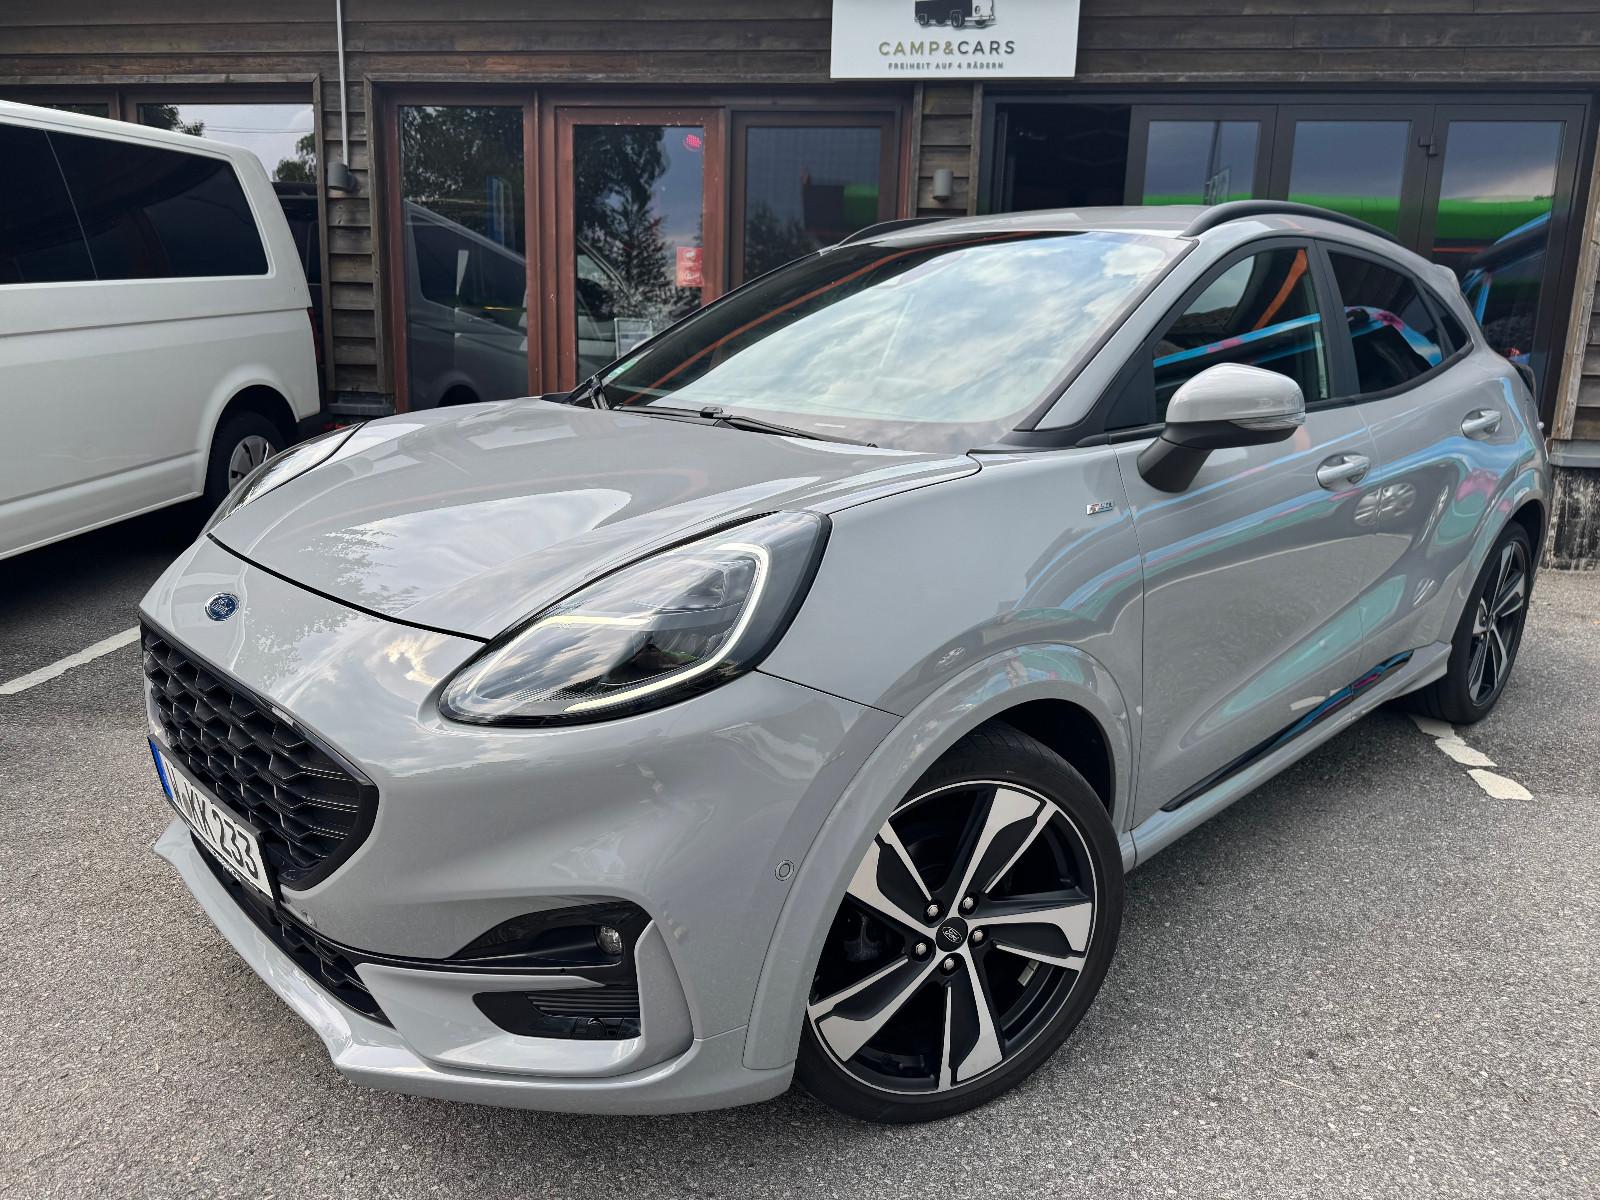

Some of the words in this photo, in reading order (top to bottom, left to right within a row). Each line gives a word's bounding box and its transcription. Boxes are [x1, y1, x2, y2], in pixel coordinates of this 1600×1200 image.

[878, 41, 1015, 56] CAMP&CARS
[888, 62, 931, 70] FREIHEIT
[935, 62, 952, 70] AUF
[966, 61, 1004, 70] RÄDERN
[212, 809, 259, 880] 233
